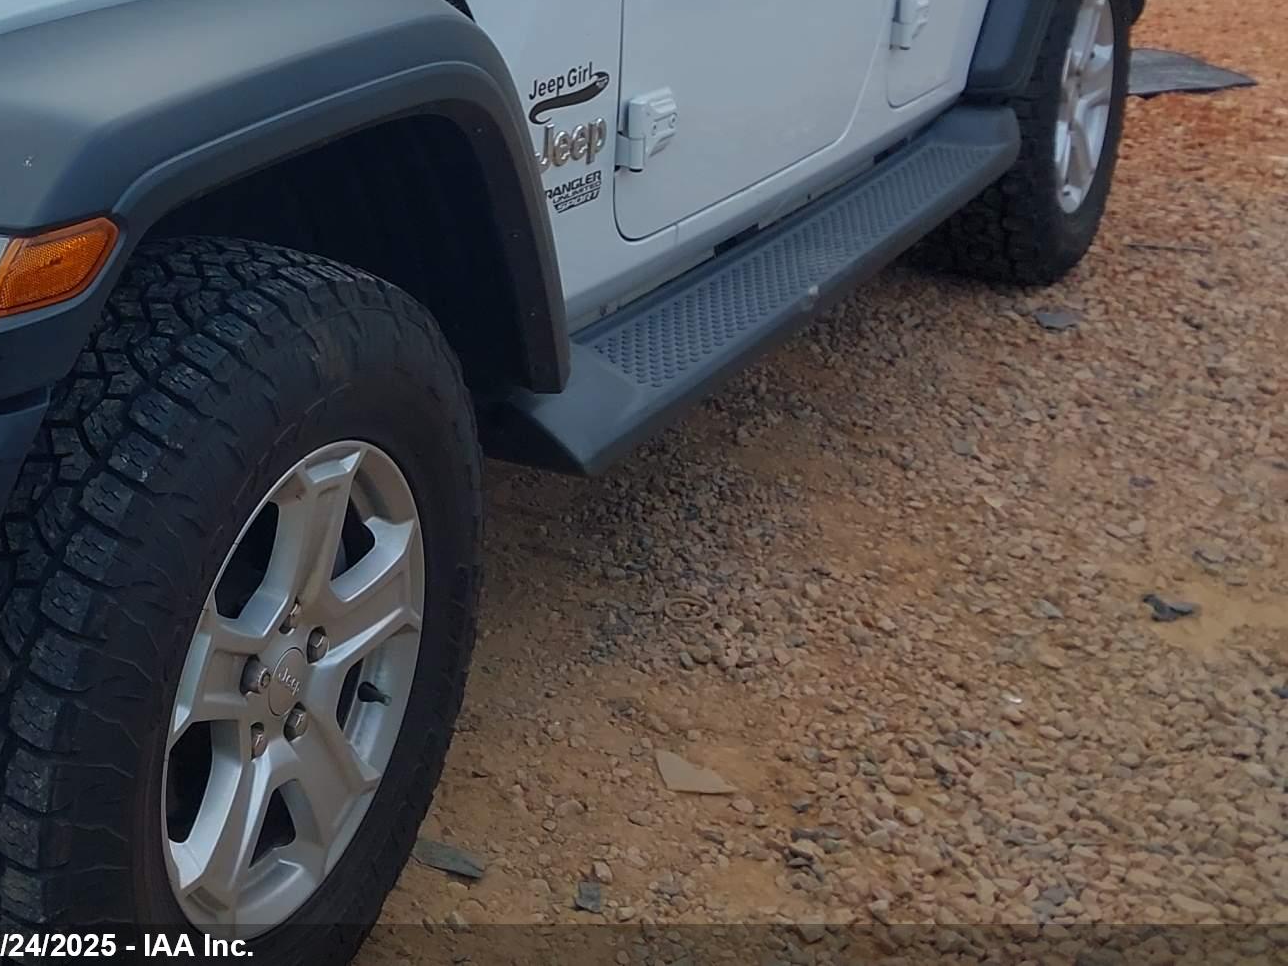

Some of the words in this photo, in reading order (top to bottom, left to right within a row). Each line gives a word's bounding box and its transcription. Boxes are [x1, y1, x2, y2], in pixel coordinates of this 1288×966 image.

[528, 75, 565, 101] Jeep
[567, 61, 593, 88] Girl
[534, 118, 607, 174] Jeep
[544, 170, 601, 199] RANGLER
[278, 667, 300, 696] Jeep
